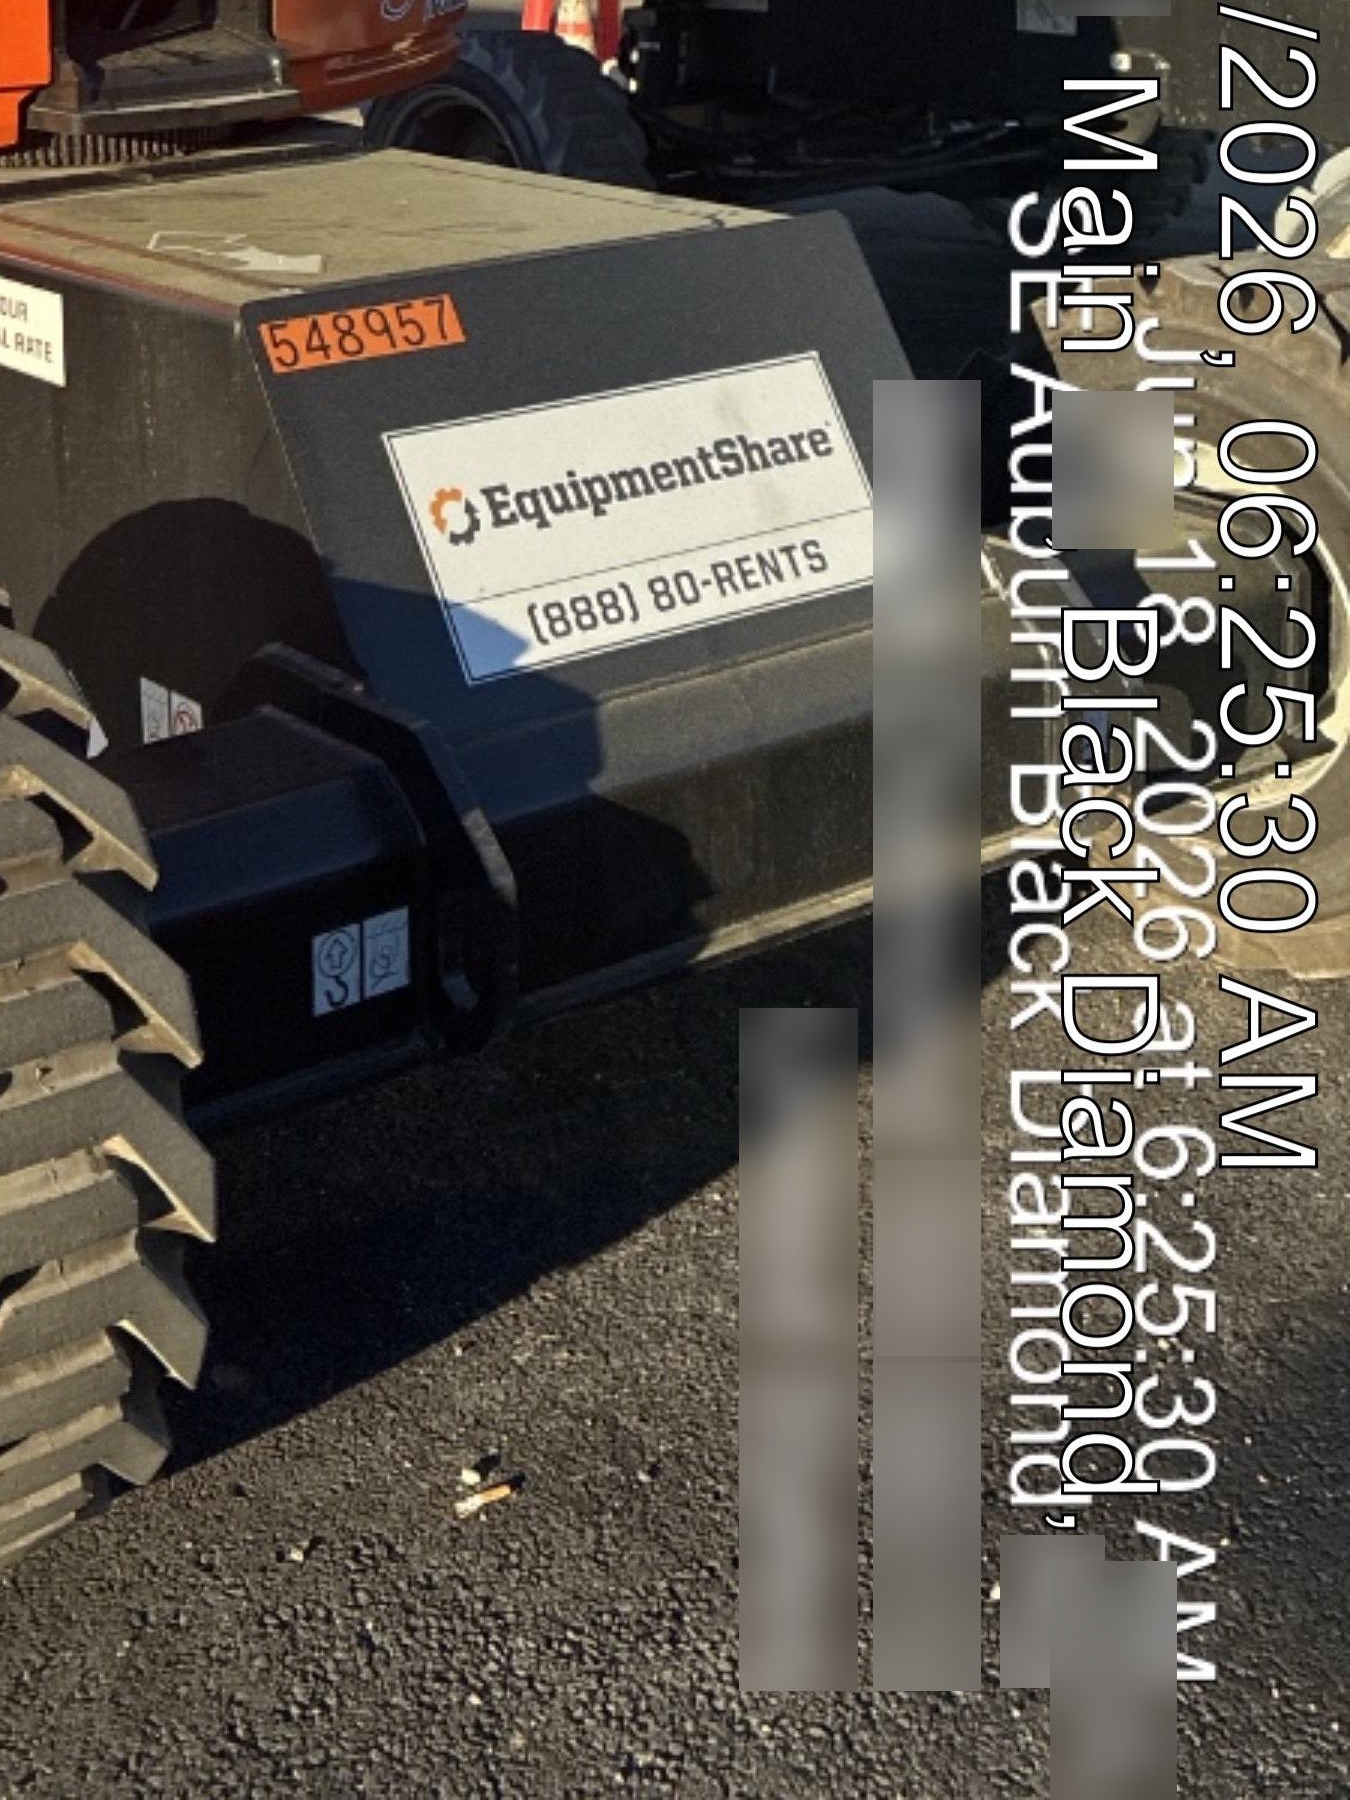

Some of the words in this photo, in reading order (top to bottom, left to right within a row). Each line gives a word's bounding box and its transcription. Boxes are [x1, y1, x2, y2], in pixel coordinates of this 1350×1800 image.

[14, 331, 53, 364] RATE
[268, 299, 451, 368] 548957
[480, 424, 834, 530] EquipmentShare
[527, 581, 640, 645] (888)
[650, 539, 828, 613] 80-RENTS
